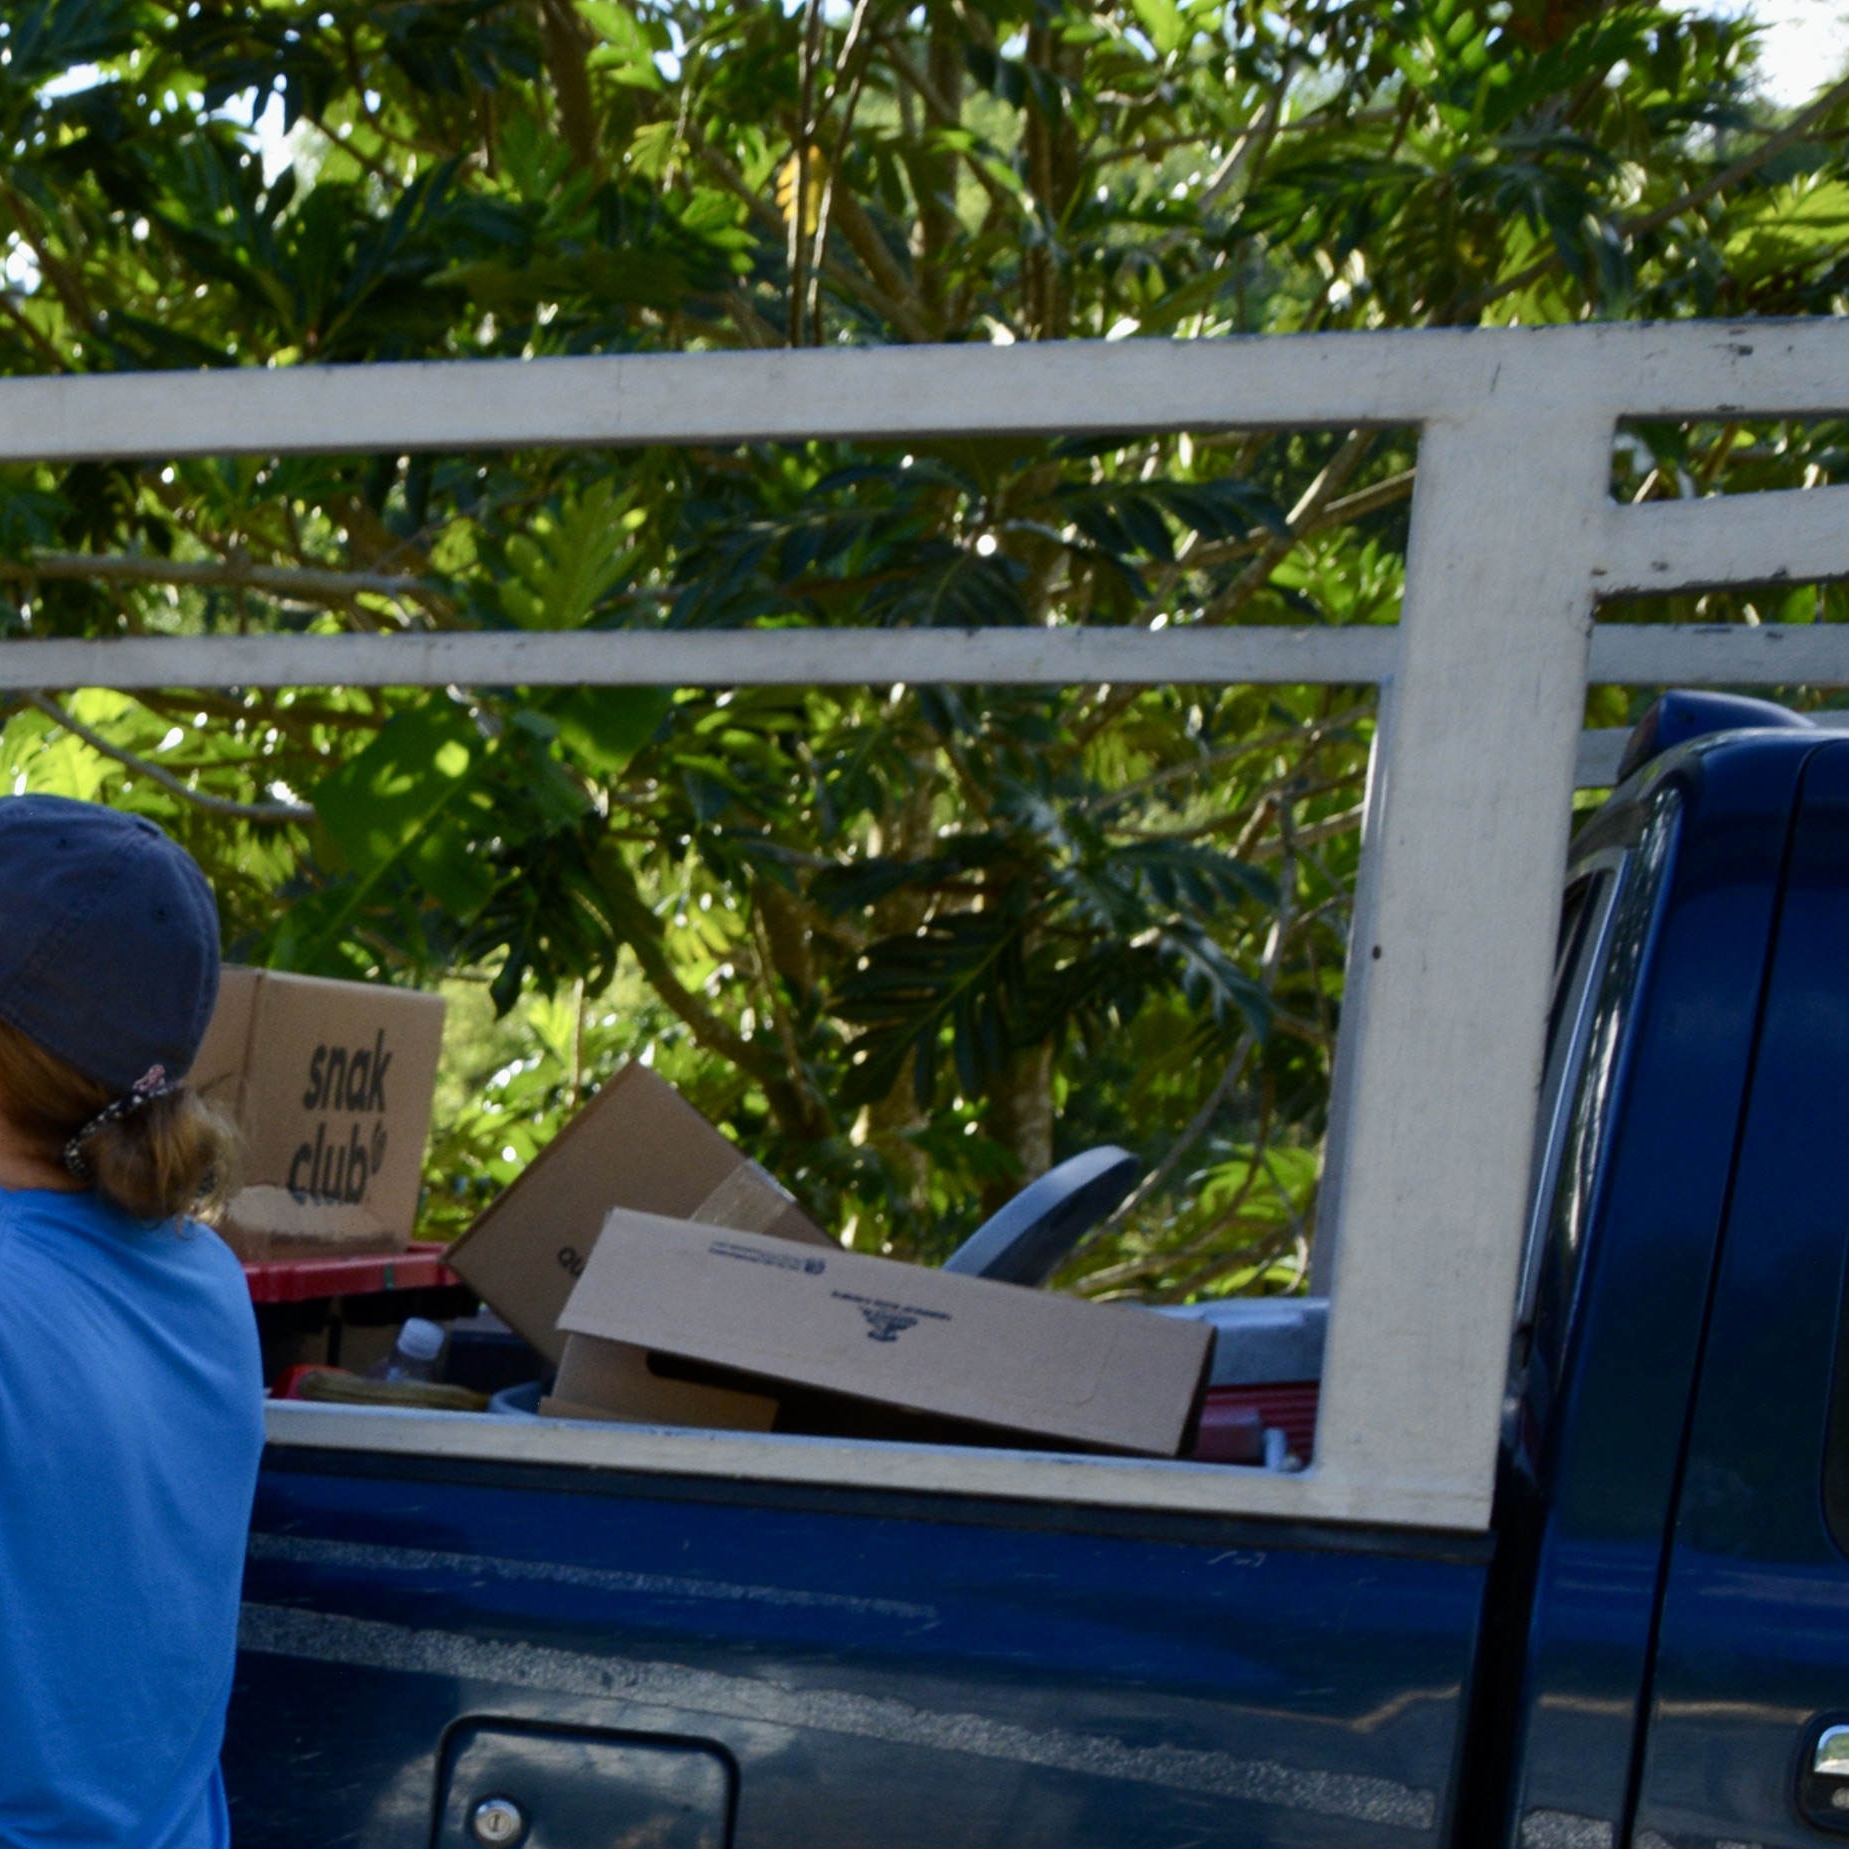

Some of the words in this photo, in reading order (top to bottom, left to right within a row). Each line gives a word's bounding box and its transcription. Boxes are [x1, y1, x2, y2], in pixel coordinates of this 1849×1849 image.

[304, 1028, 392, 1113] snak
[287, 1122, 369, 1206] club
[557, 1247, 585, 1278] QU
